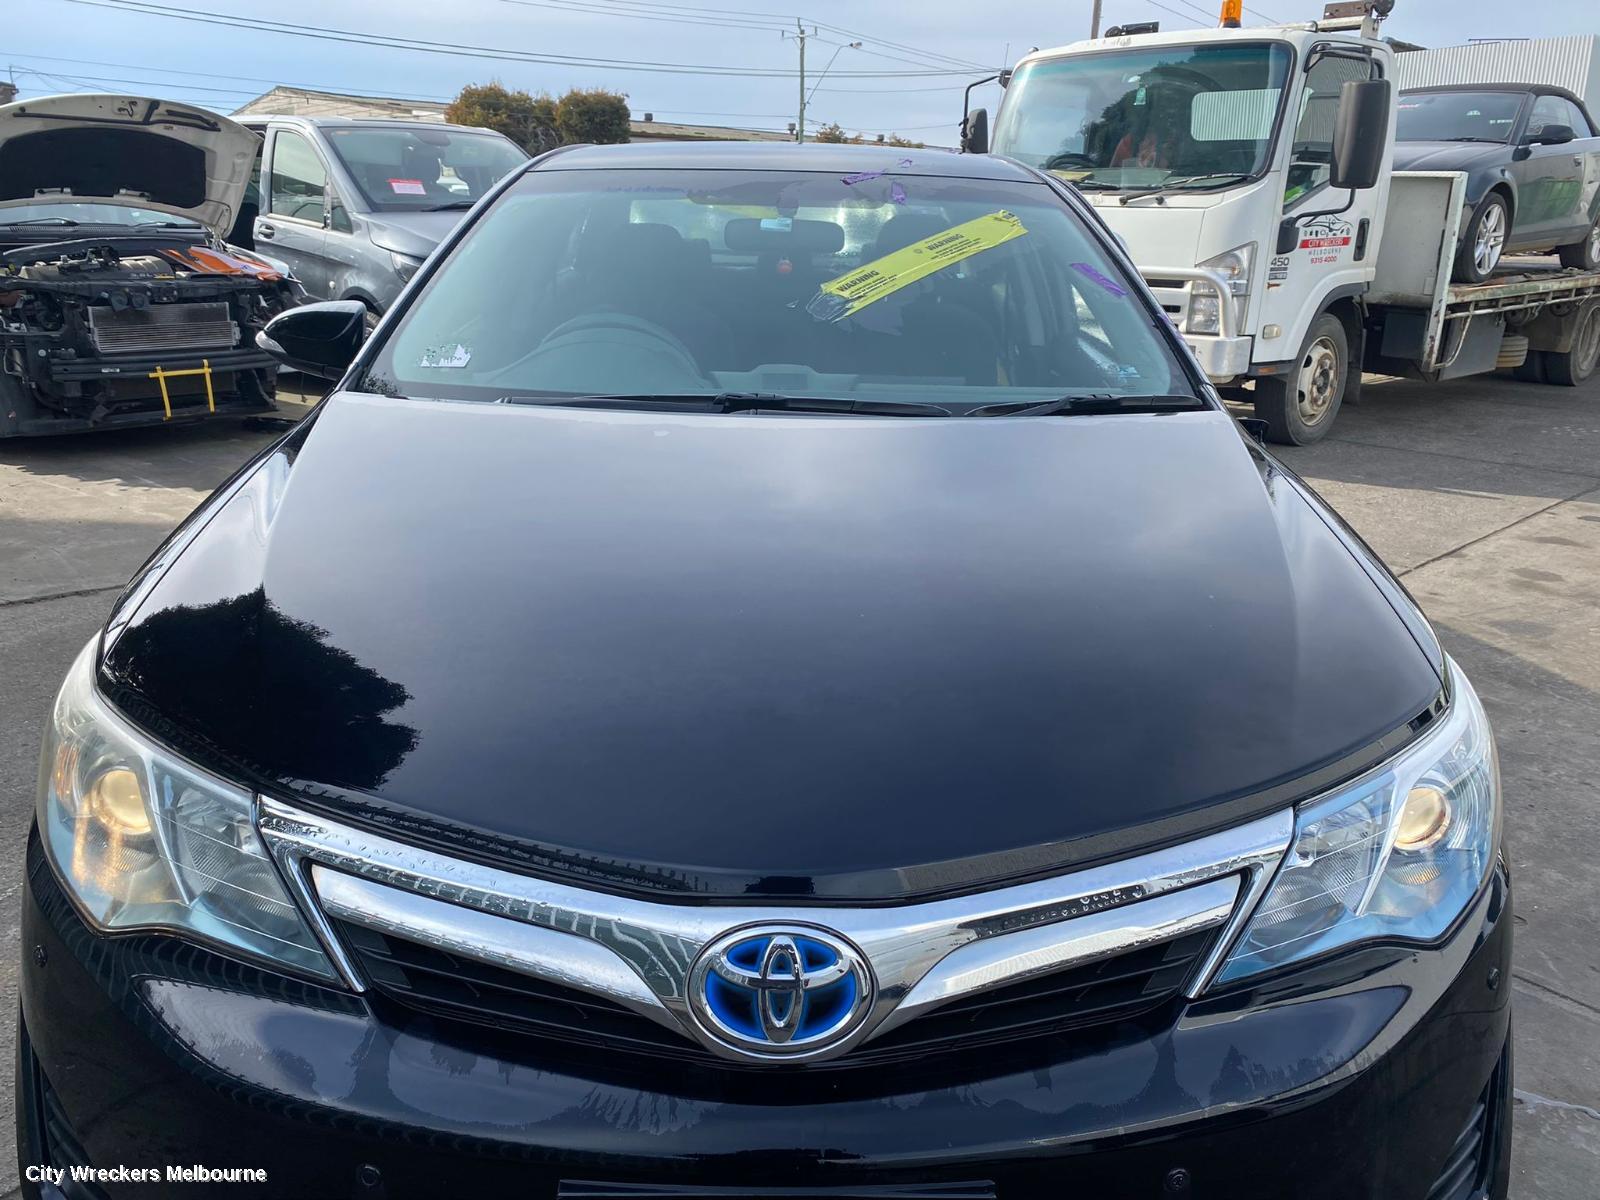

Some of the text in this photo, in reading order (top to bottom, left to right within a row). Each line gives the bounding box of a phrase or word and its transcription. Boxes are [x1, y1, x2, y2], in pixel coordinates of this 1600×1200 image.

[924, 233, 965, 251] WARNING
[1309, 240, 1320, 248] CITY
[1270, 257, 1290, 266] 450
[836, 270, 880, 292] WARNING
